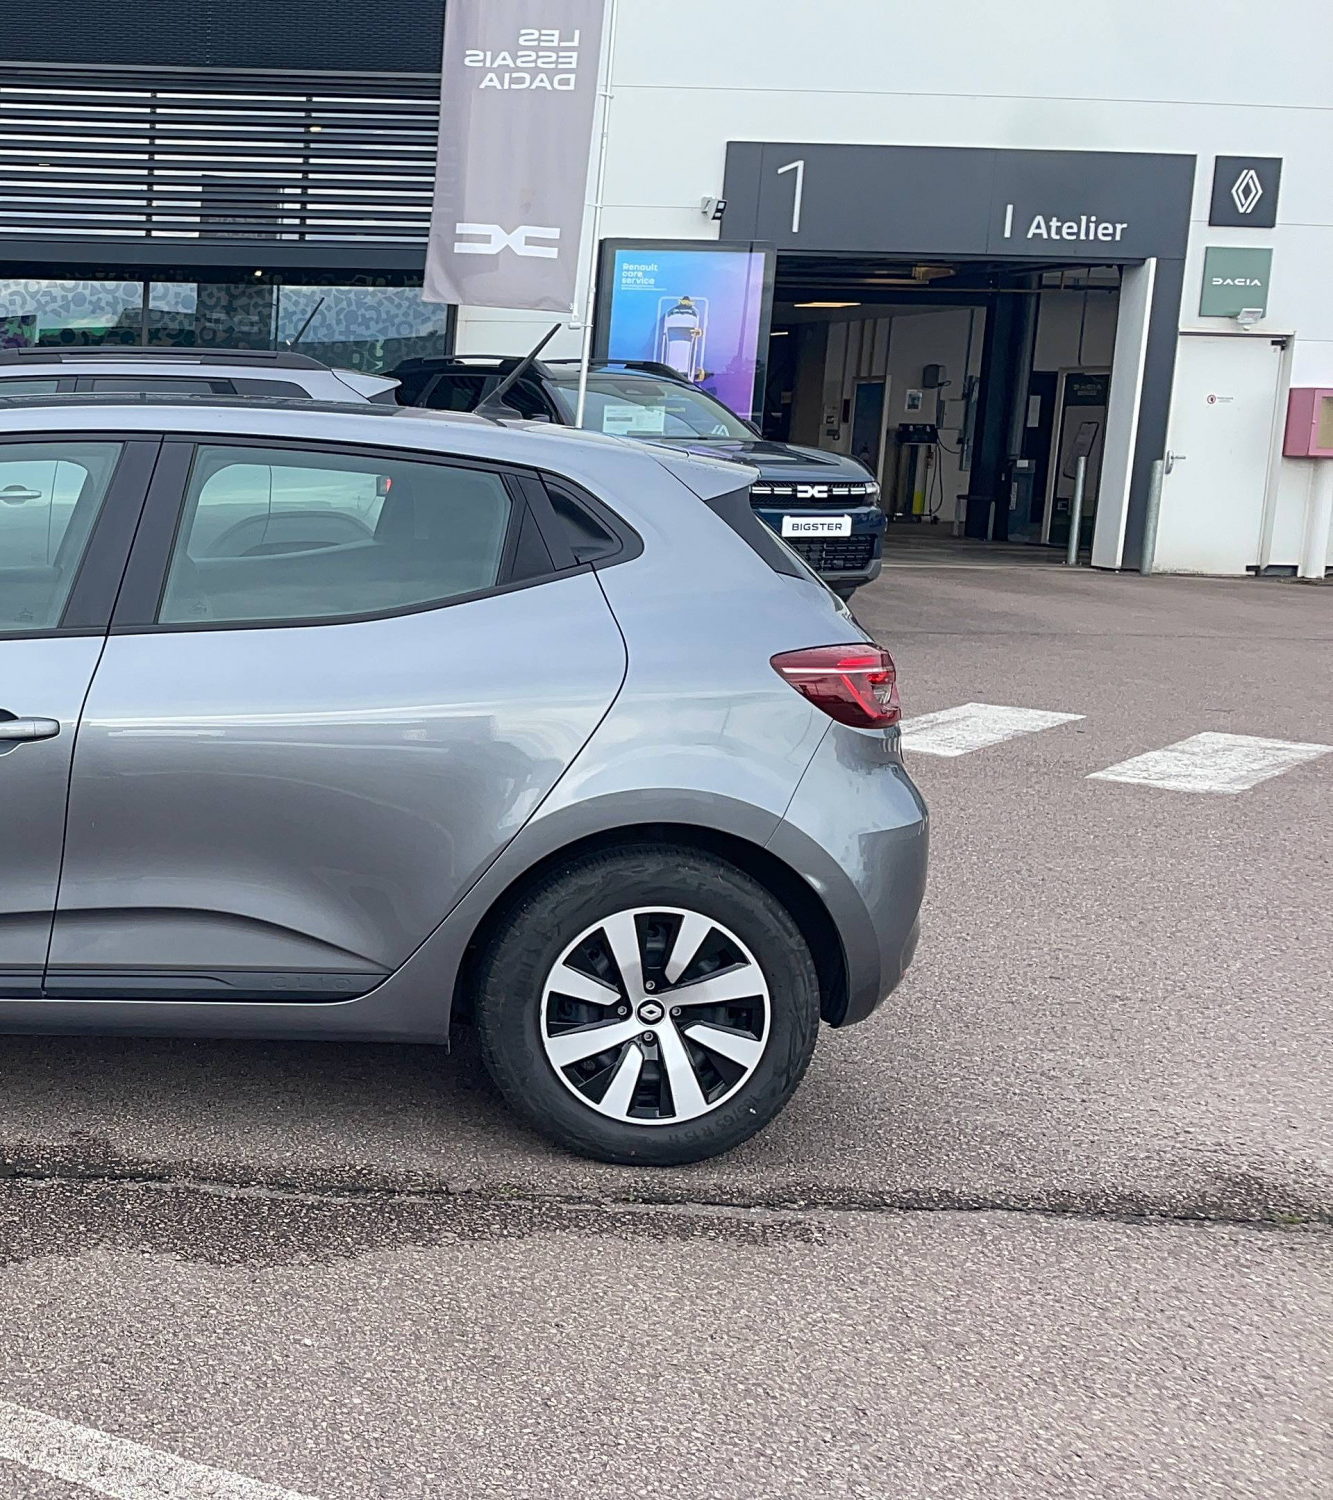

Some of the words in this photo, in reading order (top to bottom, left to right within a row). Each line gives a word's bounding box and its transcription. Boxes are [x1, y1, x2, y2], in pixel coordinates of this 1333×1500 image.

[777, 160, 804, 233] 1
[1026, 215, 1128, 242] Atelier
[622, 263, 659, 272] Renault
[621, 277, 655, 285] service
[1212, 277, 1262, 287] DACIA
[791, 523, 843, 531] BIGSTER
